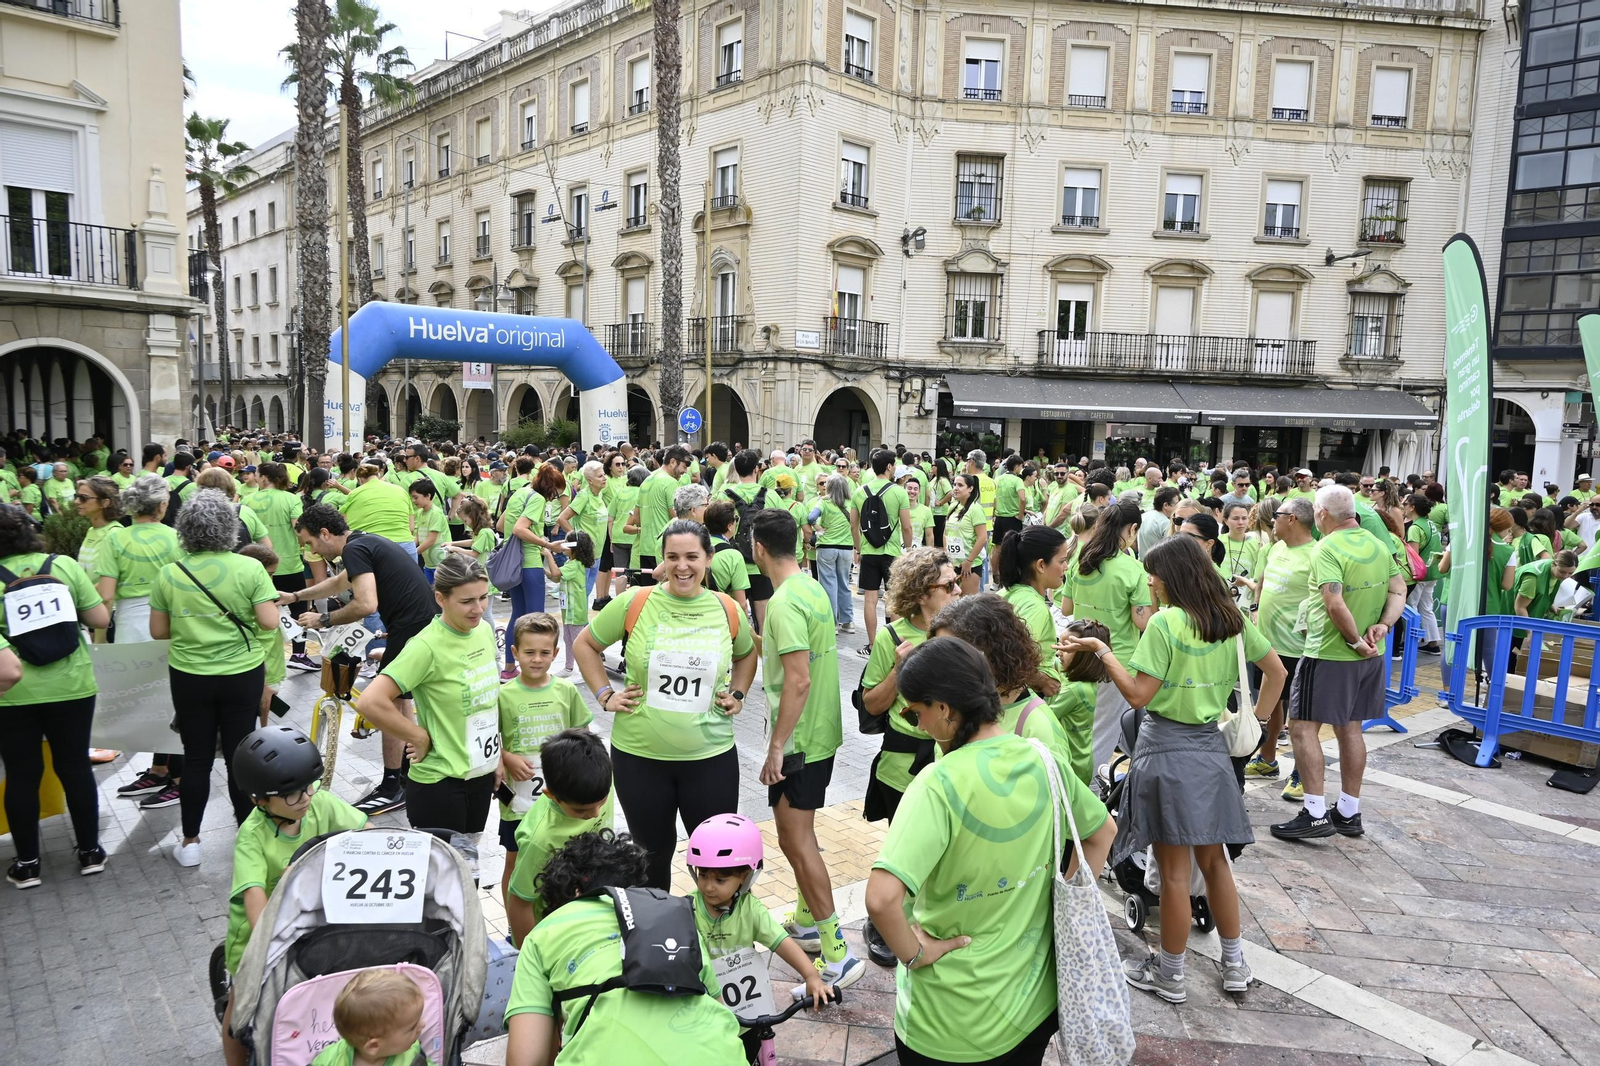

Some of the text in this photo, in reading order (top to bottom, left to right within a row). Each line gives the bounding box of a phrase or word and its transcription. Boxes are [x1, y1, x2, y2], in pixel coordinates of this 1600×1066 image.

[408, 316, 565, 351] Huelva original
[324, 399, 361, 412] Hueva
[1040, 410, 1071, 418] RESTAURANTE
[18, 598, 60, 620] 911
[658, 623, 720, 636] En marcha
[656, 637, 705, 647] contra
[659, 674, 701, 697] 201
[518, 716, 530, 724] En
[520, 724, 555, 734] contra
[1311, 818, 1328, 827] HOKA
[722, 975, 762, 1007] 02
